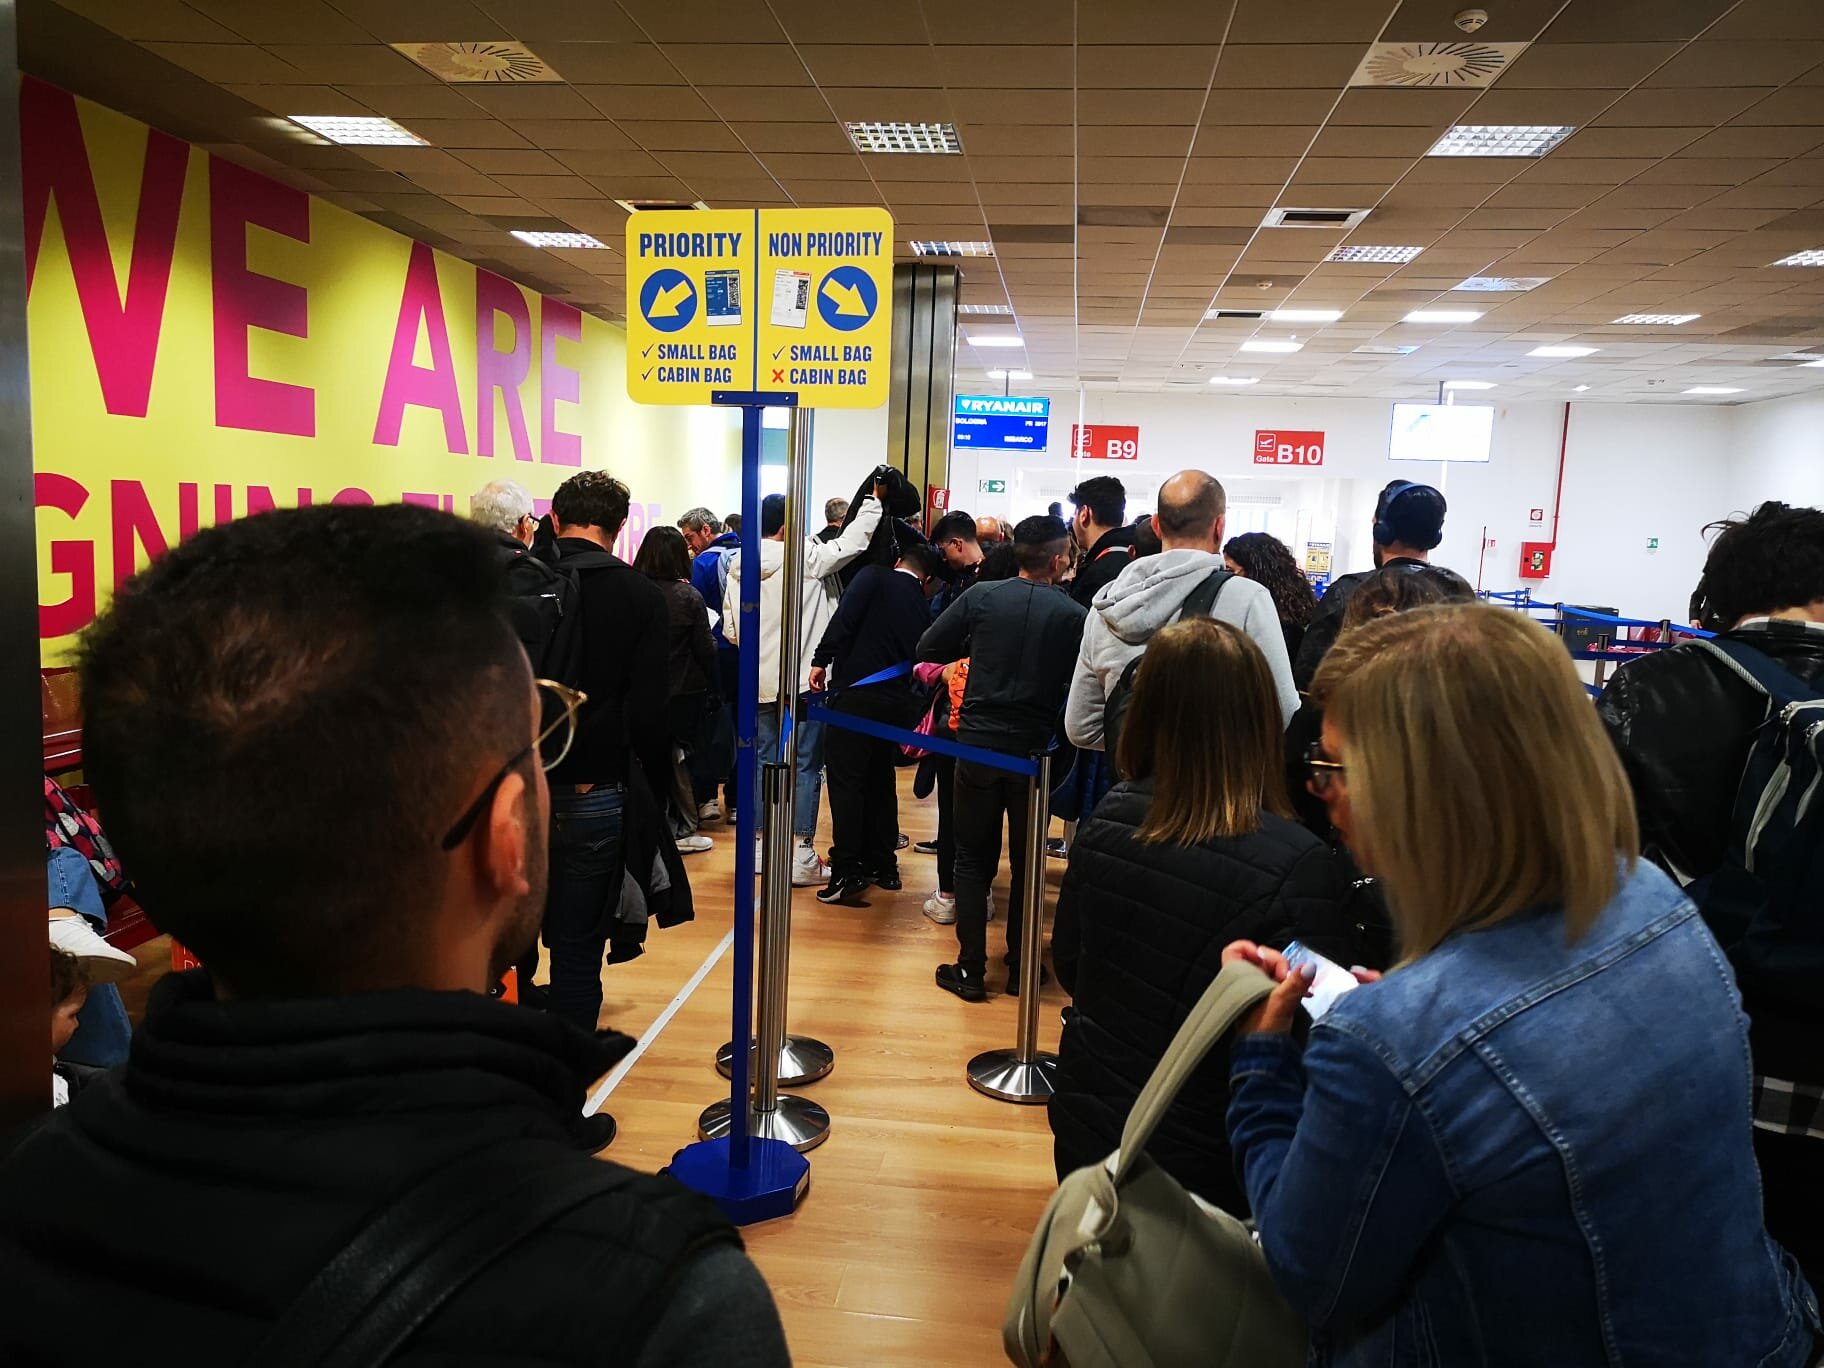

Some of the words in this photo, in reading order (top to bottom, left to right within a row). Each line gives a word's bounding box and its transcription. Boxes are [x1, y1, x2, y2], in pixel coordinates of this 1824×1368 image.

[640, 232, 742, 257] PRIORITY
[769, 232, 802, 257] NON
[807, 231, 882, 256] PRIORITY
[19, 74, 315, 437] WE
[372, 240, 582, 467] ARE
[658, 344, 704, 360] SMALL
[709, 344, 737, 360] BAG
[790, 345, 839, 361] SMALL
[843, 345, 872, 362] BAG
[658, 367, 700, 382] CABIN
[704, 367, 732, 383] BAG
[790, 368, 833, 384] CABIN
[838, 368, 867, 385] BAG
[971, 400, 1043, 413] RYANAIR
[1107, 439, 1136, 458] B9
[1278, 444, 1322, 464] B10
[1256, 455, 1274, 463] Gate
